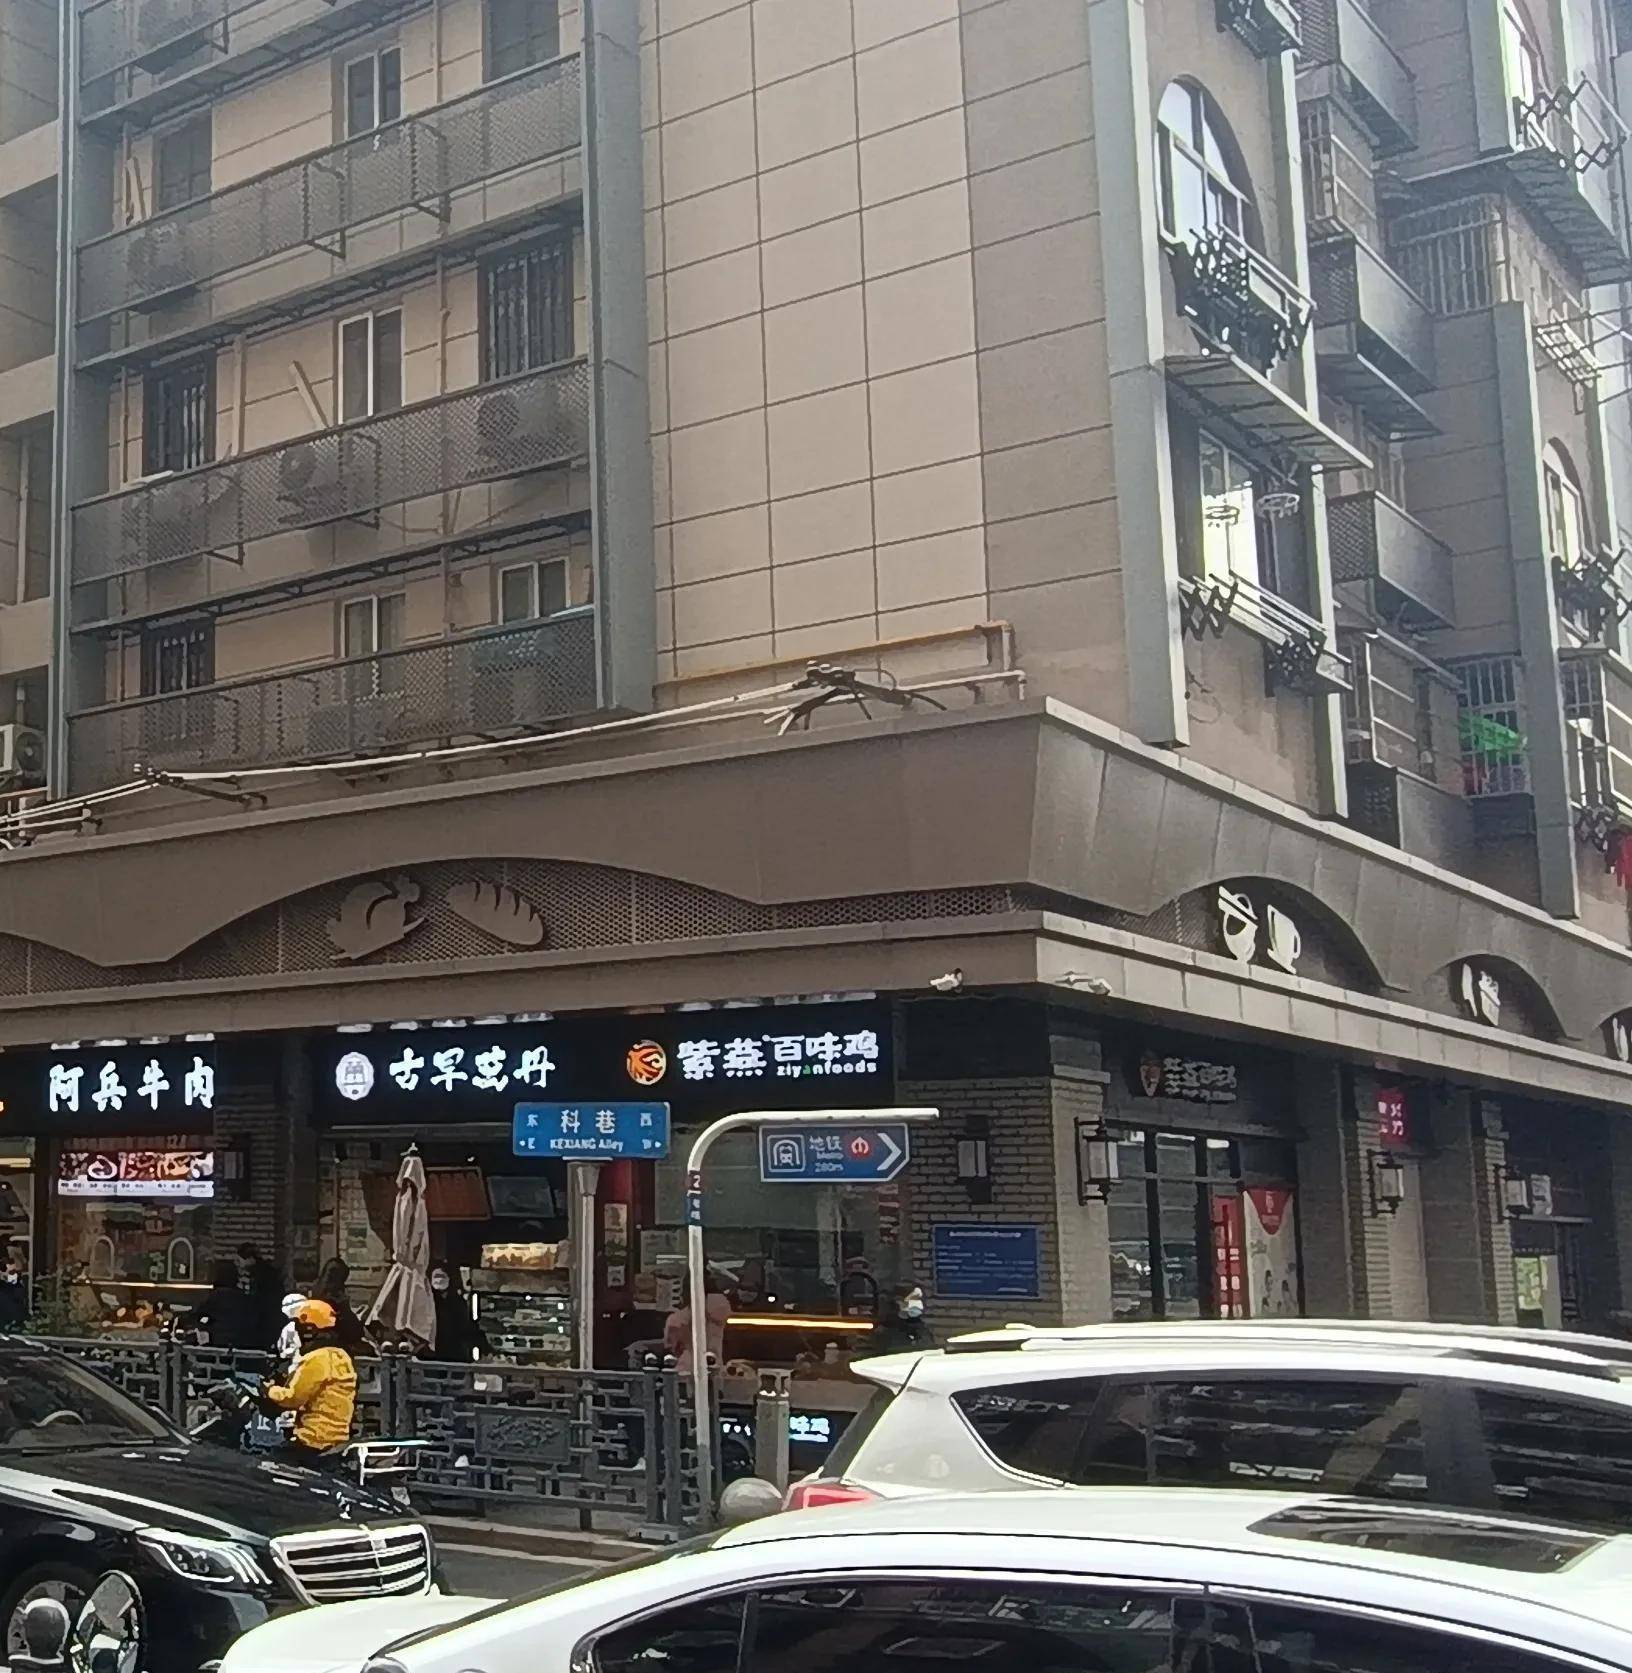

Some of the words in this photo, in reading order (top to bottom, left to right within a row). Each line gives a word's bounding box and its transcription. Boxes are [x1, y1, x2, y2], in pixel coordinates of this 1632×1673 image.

[677, 1030, 879, 1080] 紫燕百味鸡
[777, 1060, 878, 1078] ziyanfoods
[49, 1056, 215, 1112] 阿兵牛肉
[526, 1113, 539, 1128] 东
[560, 1109, 617, 1134] 科巷
[640, 1112, 653, 1127] 西
[550, 1138, 597, 1150] KEXIANG
[598, 1138, 624, 1152] Alley
[809, 1135, 843, 1151] 地铁
